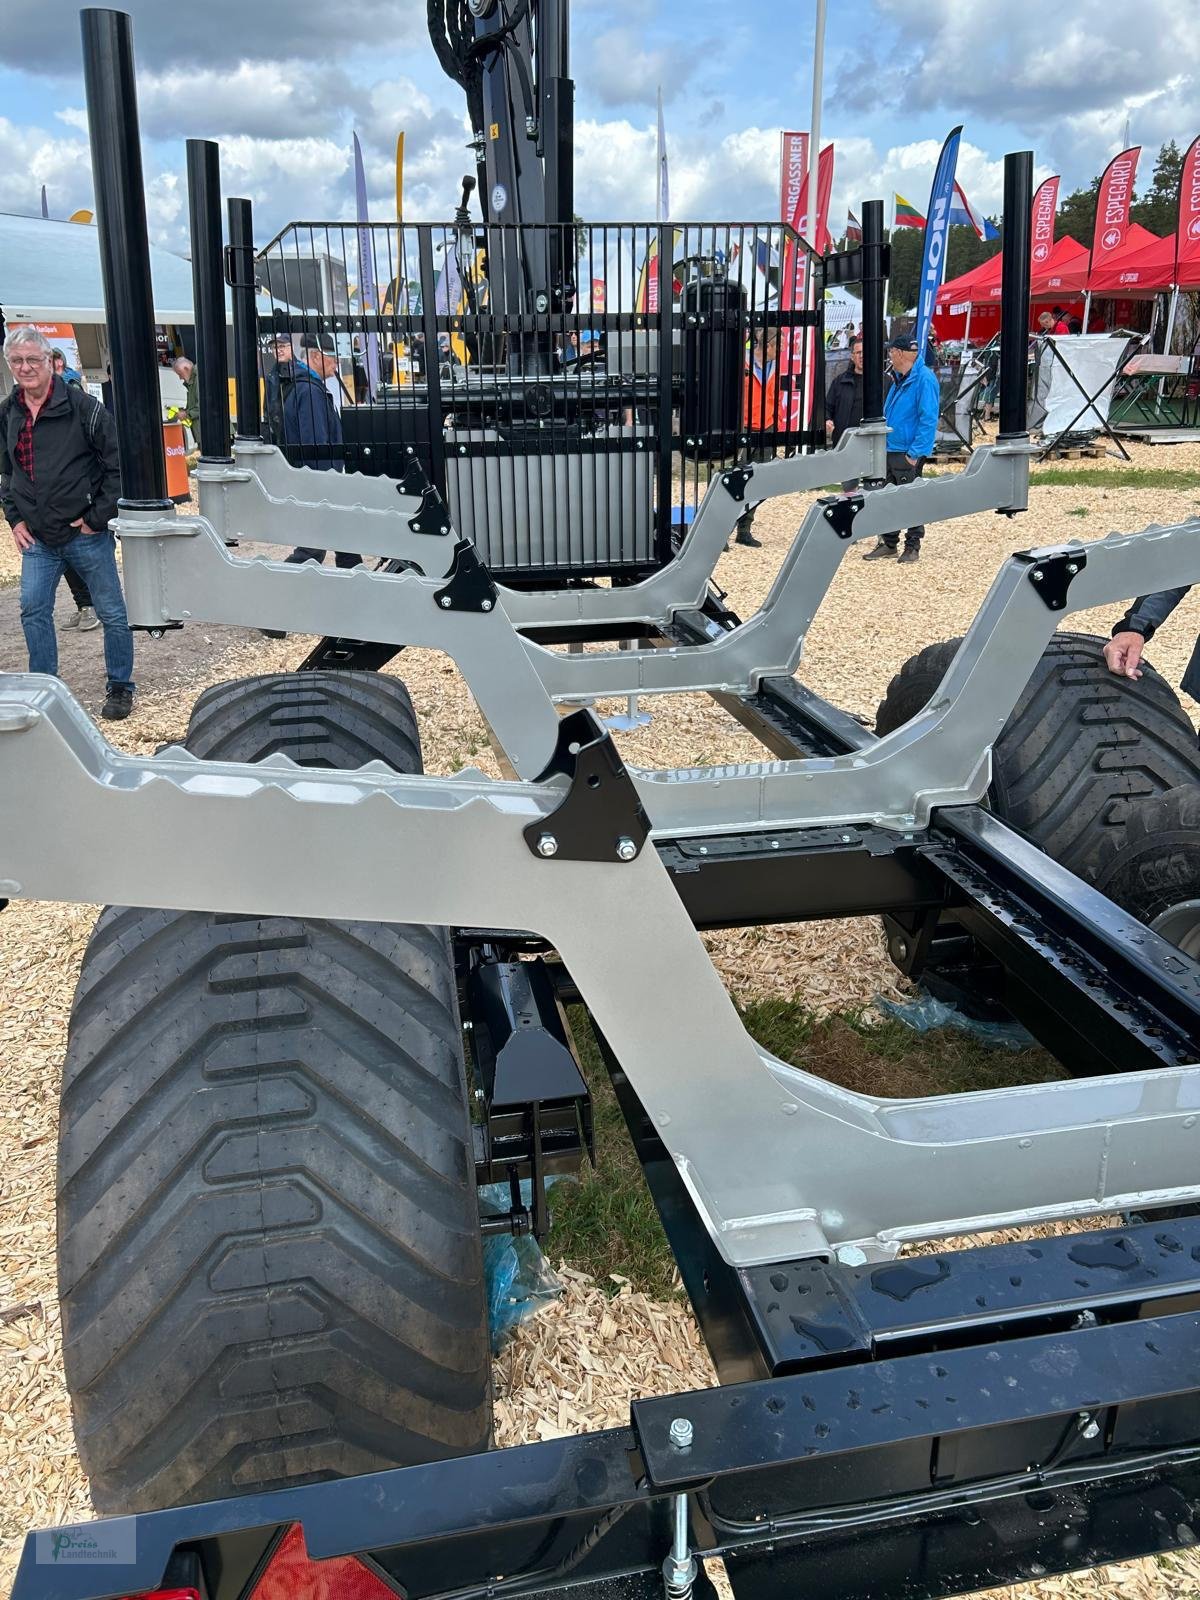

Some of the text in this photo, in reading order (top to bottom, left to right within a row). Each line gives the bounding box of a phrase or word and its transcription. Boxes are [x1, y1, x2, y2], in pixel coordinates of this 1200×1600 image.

[787, 136, 803, 222] HARGASSNER
[1105, 159, 1132, 224] ESPEGARD
[1035, 185, 1055, 240] ESPEGARD
